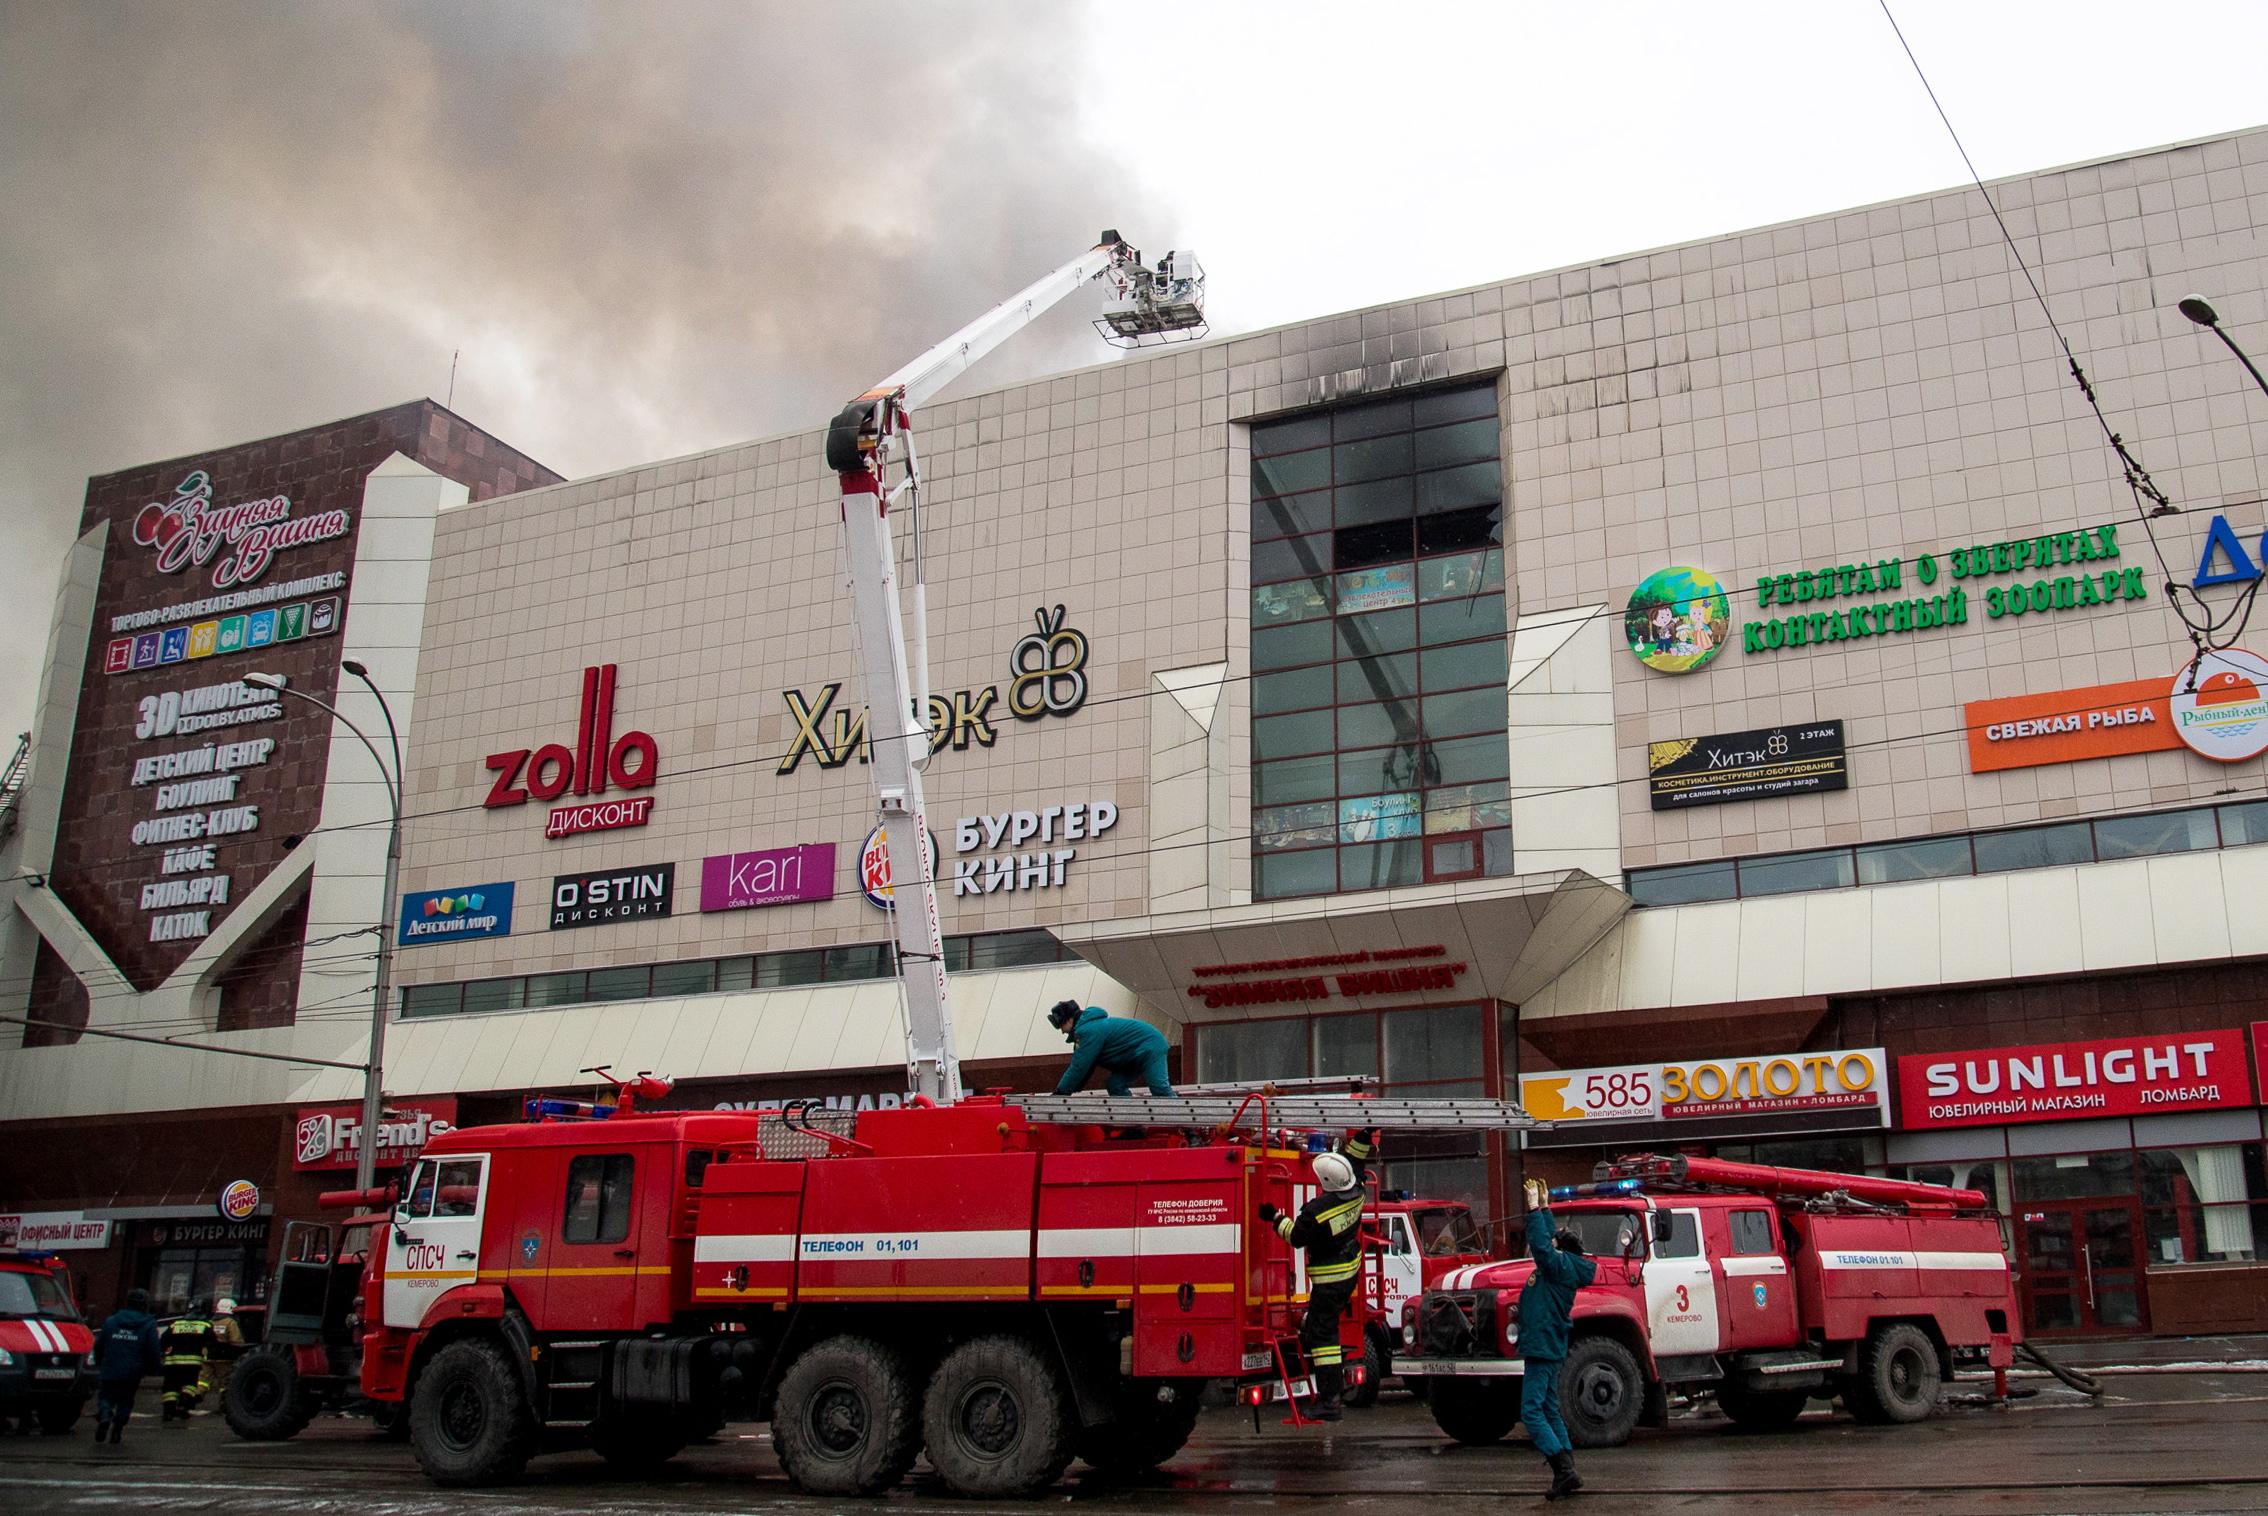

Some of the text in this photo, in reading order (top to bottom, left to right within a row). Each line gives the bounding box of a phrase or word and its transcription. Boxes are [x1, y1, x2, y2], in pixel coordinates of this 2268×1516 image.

[158, 497, 287, 572] Зимняя
[213, 511, 344, 588] Вишня
[1757, 525, 2120, 607] РЕБЯТАМ О ЗВЕРЯТАХ
[2192, 514, 2268, 590] Д
[111, 571, 345, 633] ТОРГОВО-РАЗВЛЕКАТЕЛЬНЫЙ КОМПЛЕКС
[1743, 566, 2147, 653] КОНТАКТНЫЙ ЗООПАРК
[181, 674, 286, 715] КИНОТЕ
[136, 691, 182, 739] 3D
[236, 703, 283, 722] ATMOS
[1986, 706, 2156, 741] СВЕЖАЯ РЫБА
[483, 663, 659, 809] zolla
[776, 683, 999, 776] Хиэк
[1800, 728, 1835, 740] 2 ЭТАЖ
[131, 738, 275, 786] ДЕТСКИЙ ЦЕНТР
[156, 775, 240, 811] БОУЛИНГ
[1673, 793, 1687, 801] для
[1689, 789, 1721, 798] салонов
[1722, 785, 1755, 796] красоты
[1764, 779, 1791, 790] студий
[1793, 778, 1819, 787] загара
[132, 805, 258, 846] ФИТНЕС-КЛУБ
[547, 799, 649, 836] ДИСКОНТ
[955, 801, 1119, 852] БУРГЕР
[161, 844, 218, 874] КАФЕ
[729, 846, 802, 896] kari
[954, 849, 1076, 897] КИНГ
[140, 875, 230, 910] БИЛЬЯРД
[867, 860, 891, 893] KI
[555, 902, 664, 926] ДИСКОНТ
[728, 898, 748, 908] обувь
[150, 911, 212, 942] КАТОК
[407, 914, 497, 936] Детский мир
[1586, 1053, 1875, 1109] 585 ЗОЛОТО
[1926, 1042, 2215, 1097] SUNLIGHT
[1586, 1107, 1652, 1118] ювелирная сеть
[1673, 1094, 1866, 1113] ЮВЕЛИРНЫЙ МАГАЗИН ЛОМБАРД
[1928, 1084, 2220, 1119] ЮВЕЛИРНЫЙ МАГАЗИН ЛОМБАРД
[333, 1115, 450, 1149] Frend's
[335, 1148, 399, 1163] ДИСОНТ
[228, 1187, 256, 1201] BURGER
[228, 1196, 257, 1213] KING
[1153, 1199, 1223, 1209] ТЕЛЕФОН ДОВЕРИЯ
[21, 1222, 104, 1241] ОФИСНЫЙ ЦЕНТР
[175, 1223, 267, 1241] БУРГЕР КИНГ
[803, 1239, 918, 1254] ТЕЛЕФОН 01,101
[407, 1244, 445, 1270] СПСЧ
[1837, 1254, 1879, 1265] ТЕЛЕФОН
[408, 1280, 439, 1288] КЕМЕРОВО
[1368, 1278, 1398, 1294] ССЧ
[1675, 1285, 1690, 1312] 3
[1666, 1313, 1702, 1322] КЕМЕРОВО
